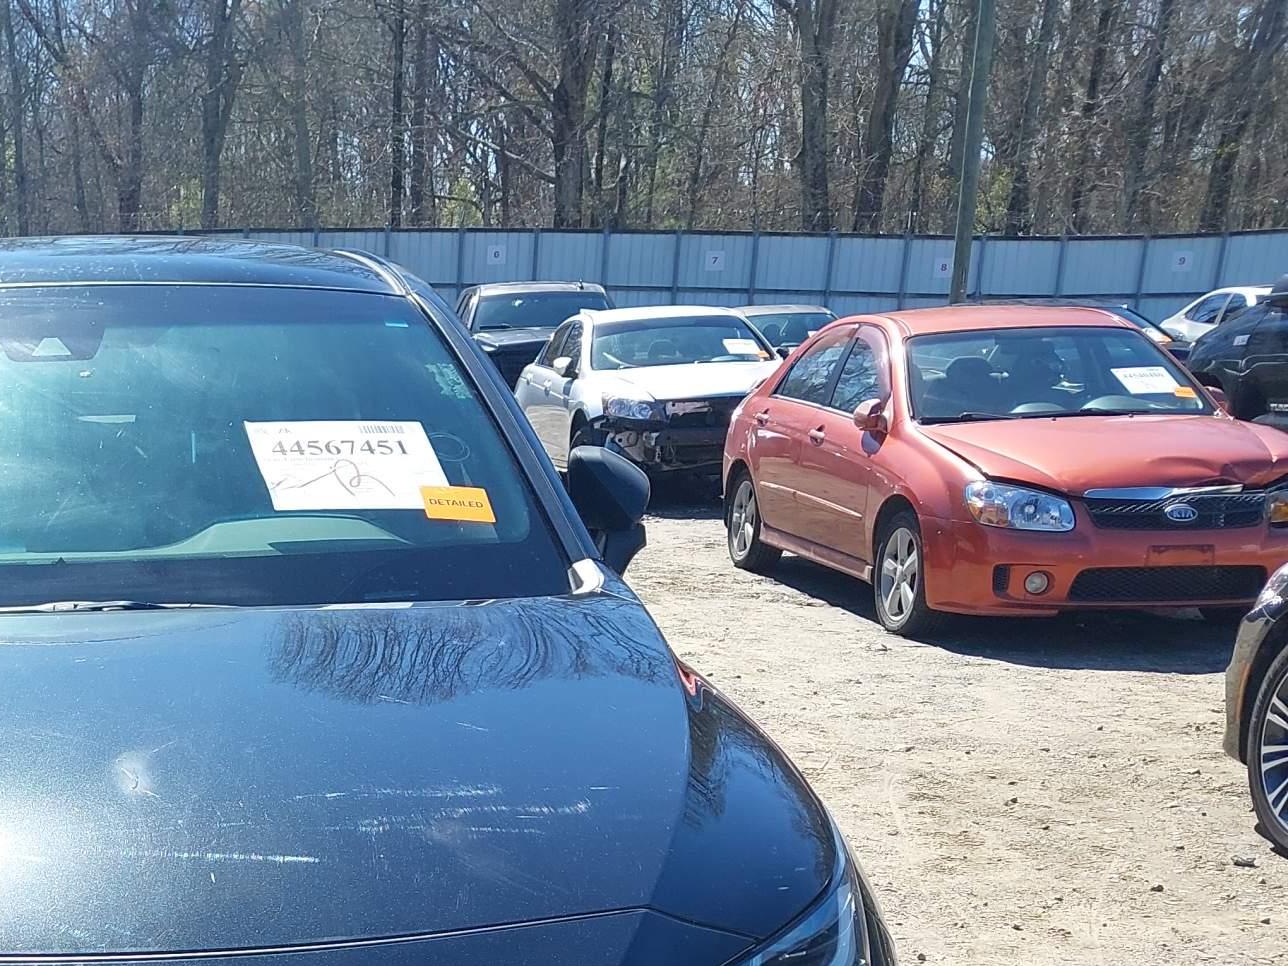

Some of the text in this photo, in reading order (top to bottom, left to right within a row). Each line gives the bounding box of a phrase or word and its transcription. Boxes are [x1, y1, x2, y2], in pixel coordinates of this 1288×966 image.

[711, 256, 719, 264] 7
[1178, 256, 1185, 265] 9
[941, 263, 947, 271] 8
[271, 439, 409, 456] 44567451
[428, 498, 484, 508] DETAILED
